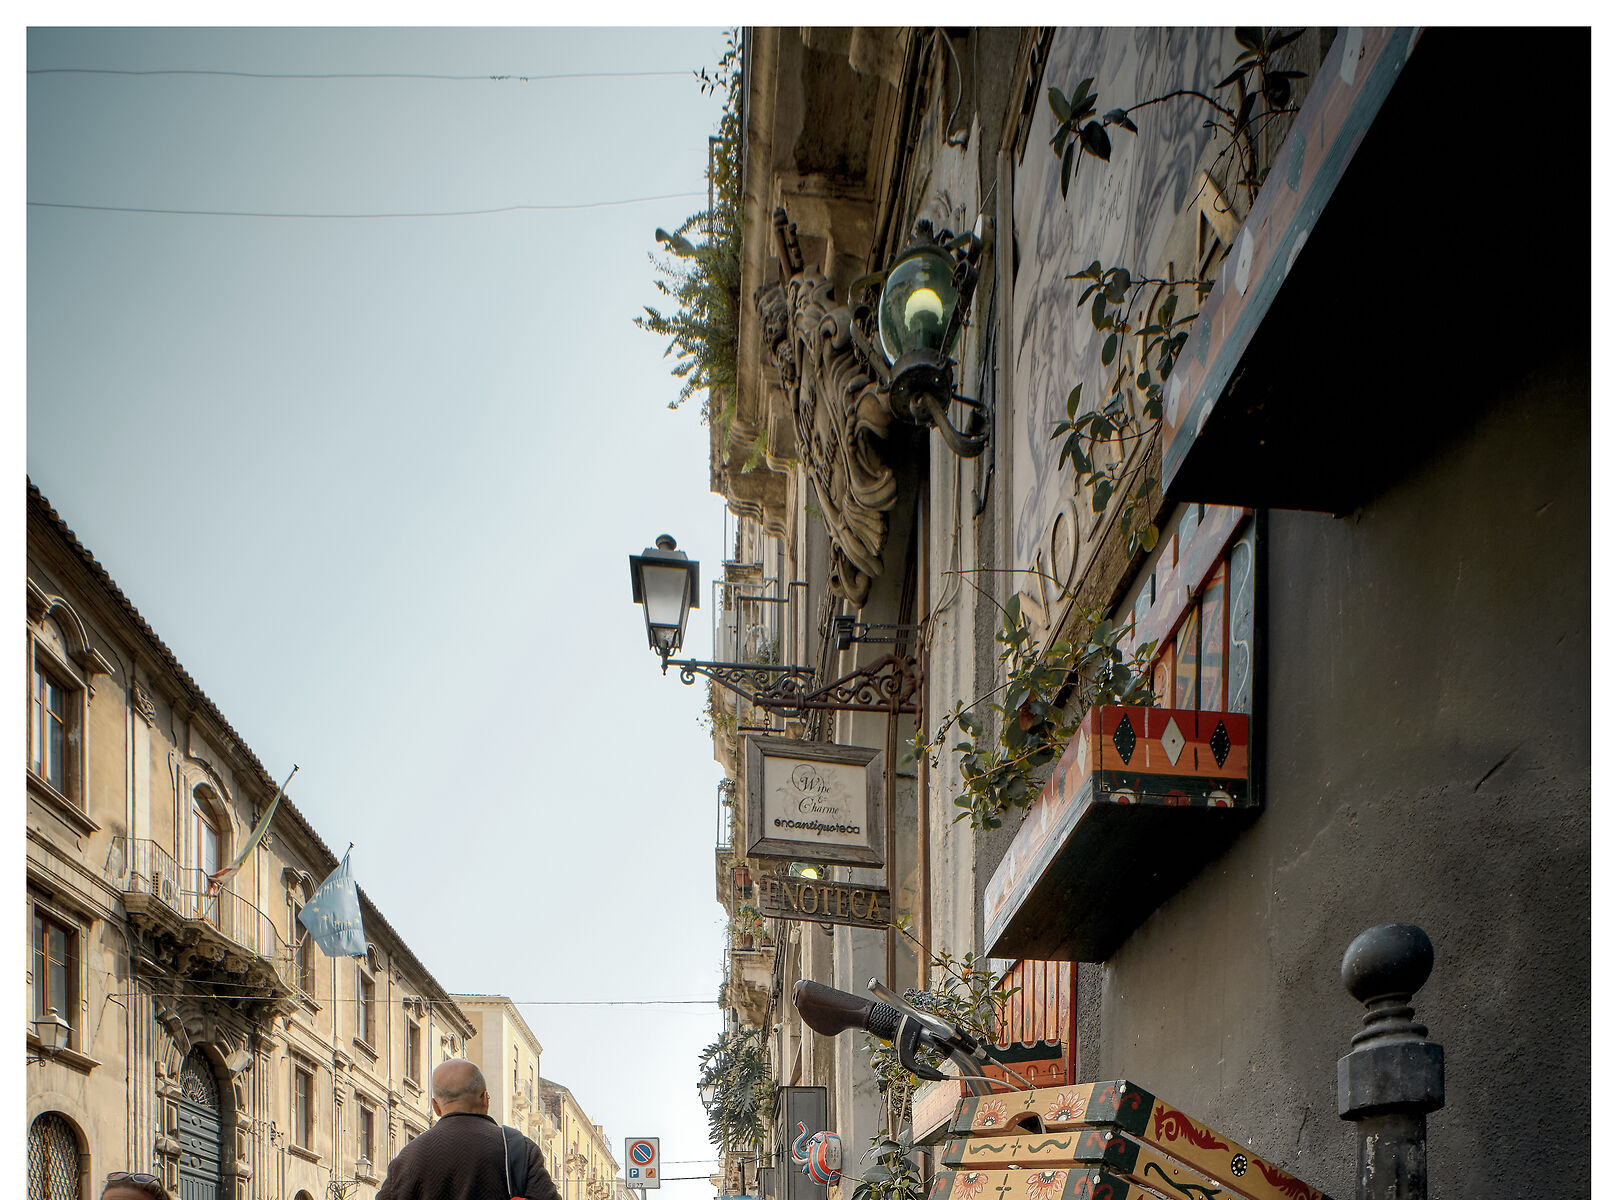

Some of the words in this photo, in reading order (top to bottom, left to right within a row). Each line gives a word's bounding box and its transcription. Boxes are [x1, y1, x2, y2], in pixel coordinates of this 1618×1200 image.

[792, 764, 831, 794] Wine
[798, 797, 840, 814] Charme
[817, 795, 827, 803] &
[774, 818, 860, 836] enoantiquoteca
[765, 879, 884, 922] ENOTECA
